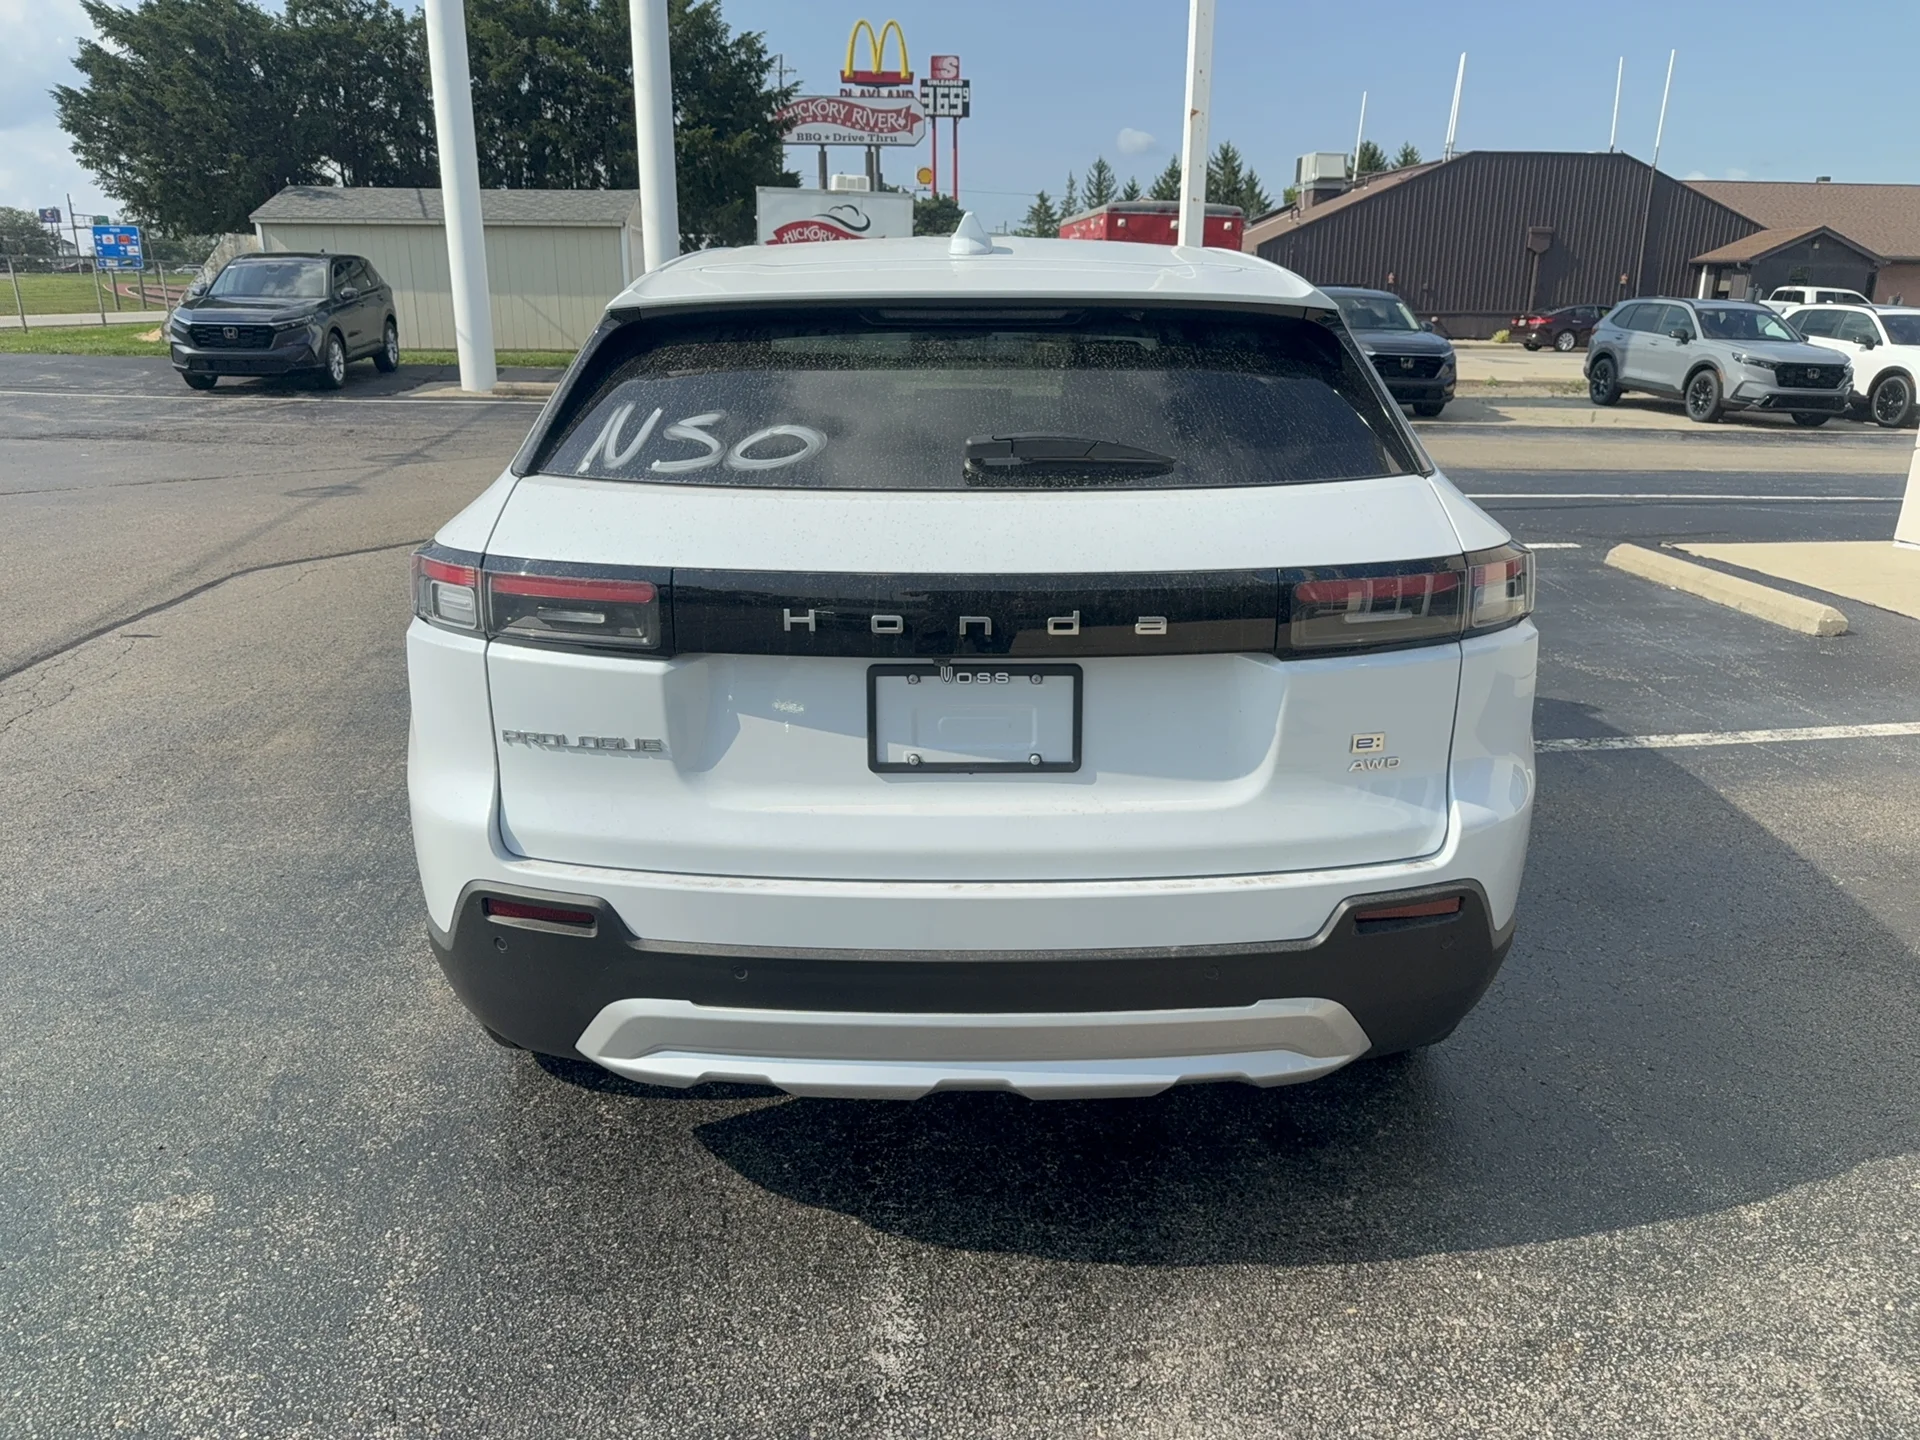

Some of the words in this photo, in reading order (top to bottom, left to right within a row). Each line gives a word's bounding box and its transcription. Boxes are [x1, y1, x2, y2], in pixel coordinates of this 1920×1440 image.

[782, 98, 849, 120] HICKORY
[796, 132, 822, 142] BBQ
[833, 132, 865, 143] Drive
[868, 133, 898, 143] Thru
[575, 402, 828, 475] NSO
[783, 608, 1168, 636] Honda
[502, 730, 663, 753] PROLOGUE
[1348, 757, 1401, 772] AWD
